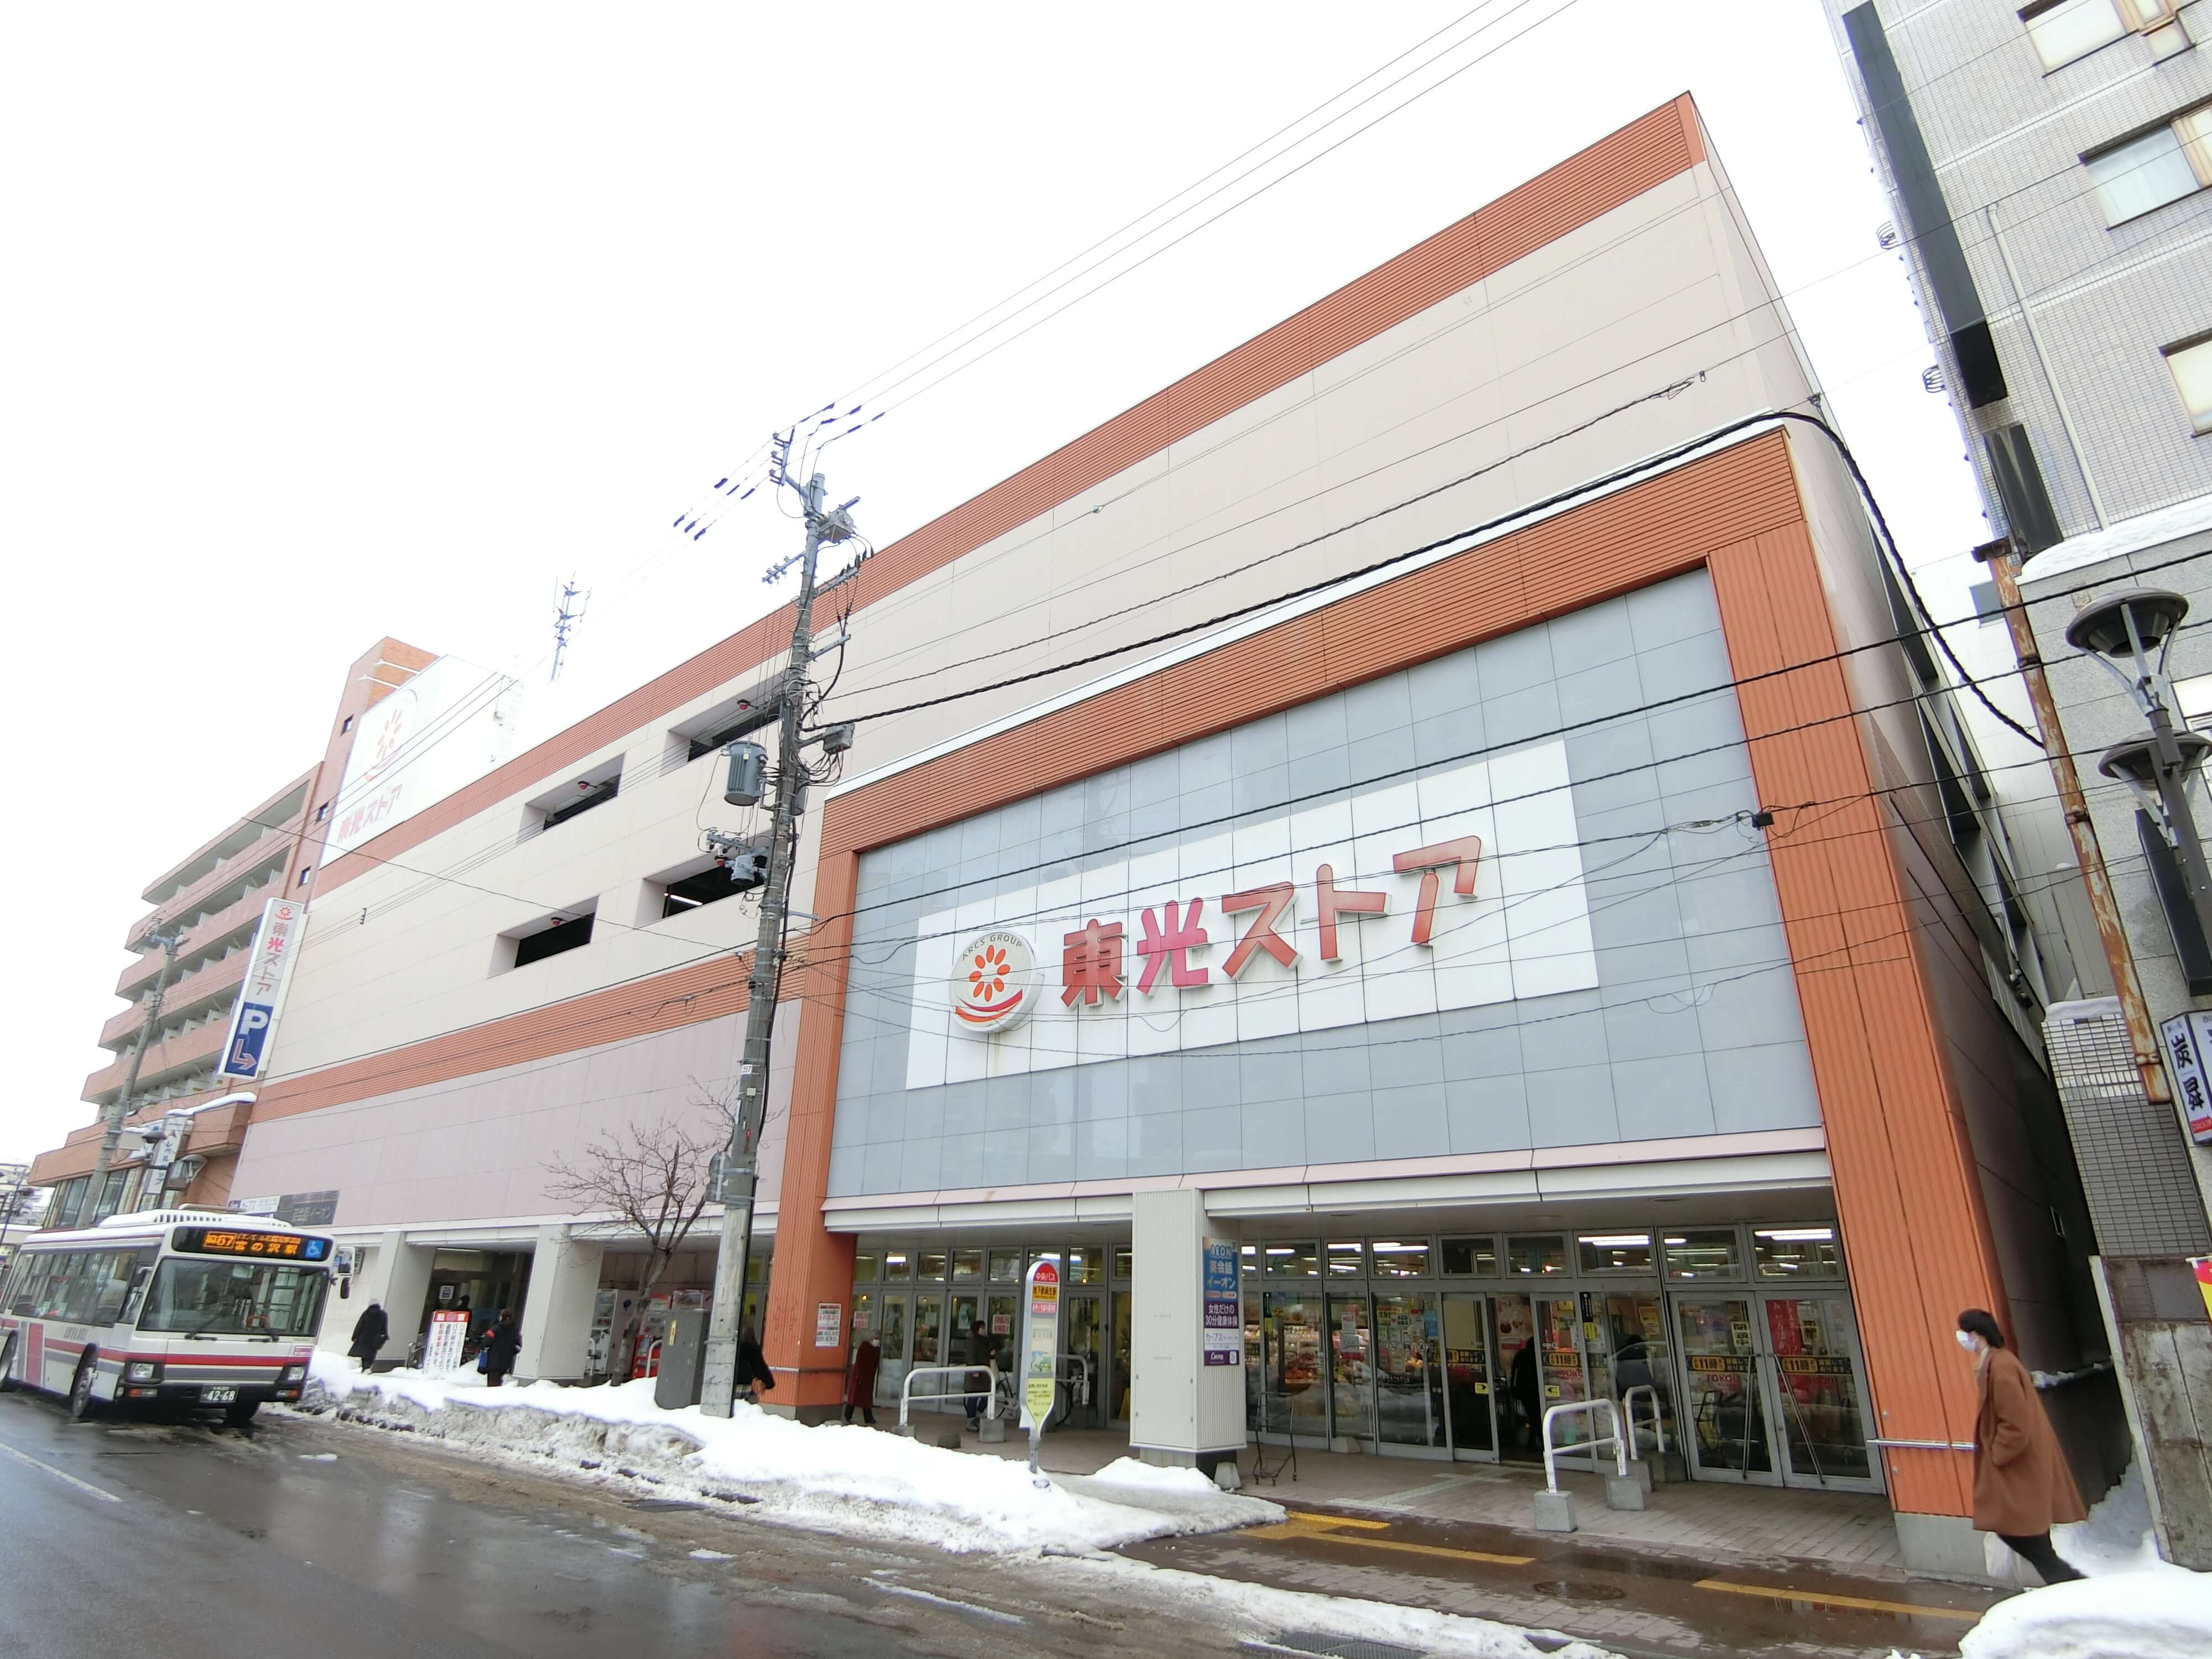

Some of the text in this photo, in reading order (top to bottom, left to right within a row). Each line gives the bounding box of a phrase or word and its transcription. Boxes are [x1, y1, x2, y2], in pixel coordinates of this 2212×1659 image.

[1061, 835, 1483, 1010] 東光ストア
[962, 933, 1022, 961] ARCS GROUP
[256, 922, 290, 995] 東光ストア
[238, 1008, 269, 1035] P
[1211, 1244, 1232, 1258] AEON
[1209, 1260, 1233, 1274] 英会話
[1035, 1272, 1056, 1281] 中央バス
[1208, 1275, 1236, 1289] イーオン
[1208, 1303, 1234, 1314] 女性だけの
[1206, 1315, 1238, 1326] 30分健康体操
